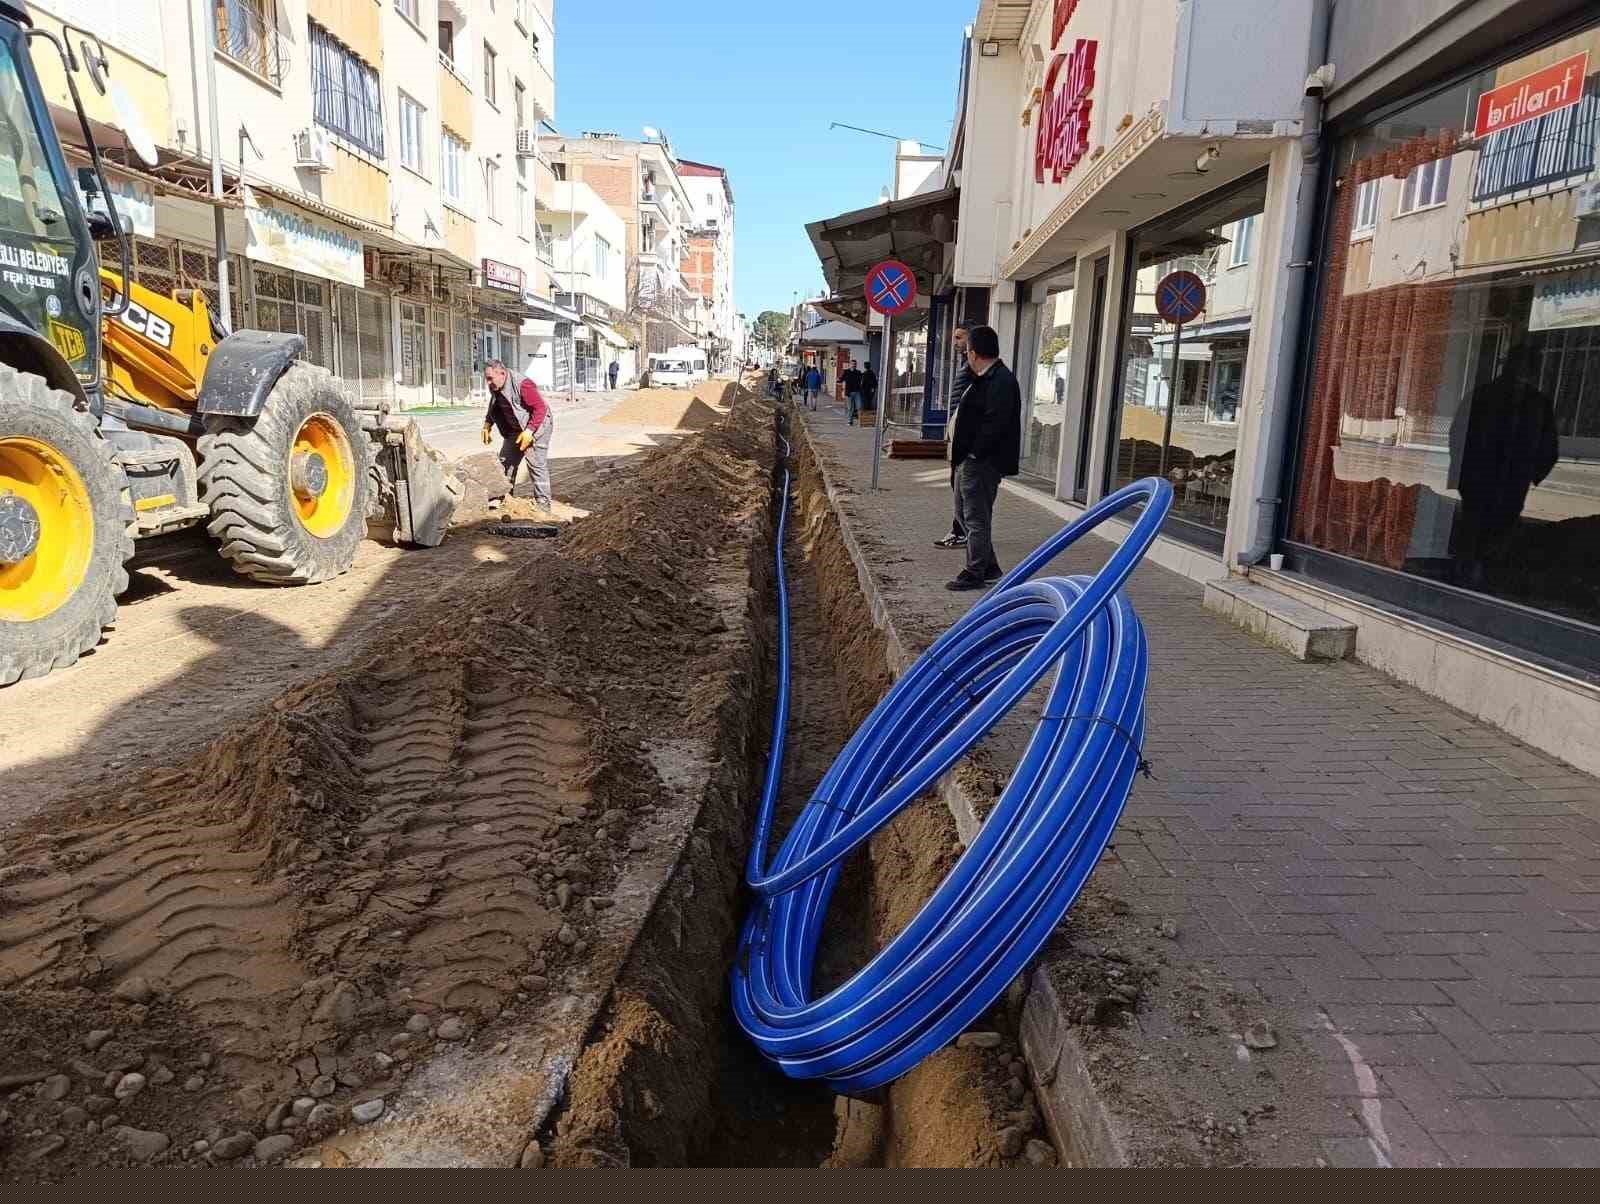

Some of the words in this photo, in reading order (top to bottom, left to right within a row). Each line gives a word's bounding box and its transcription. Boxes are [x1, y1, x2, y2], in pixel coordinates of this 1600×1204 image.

[1487, 65, 1577, 128] brillant
[56, 327, 85, 359] JCB
[101, 293, 171, 347] JCB
